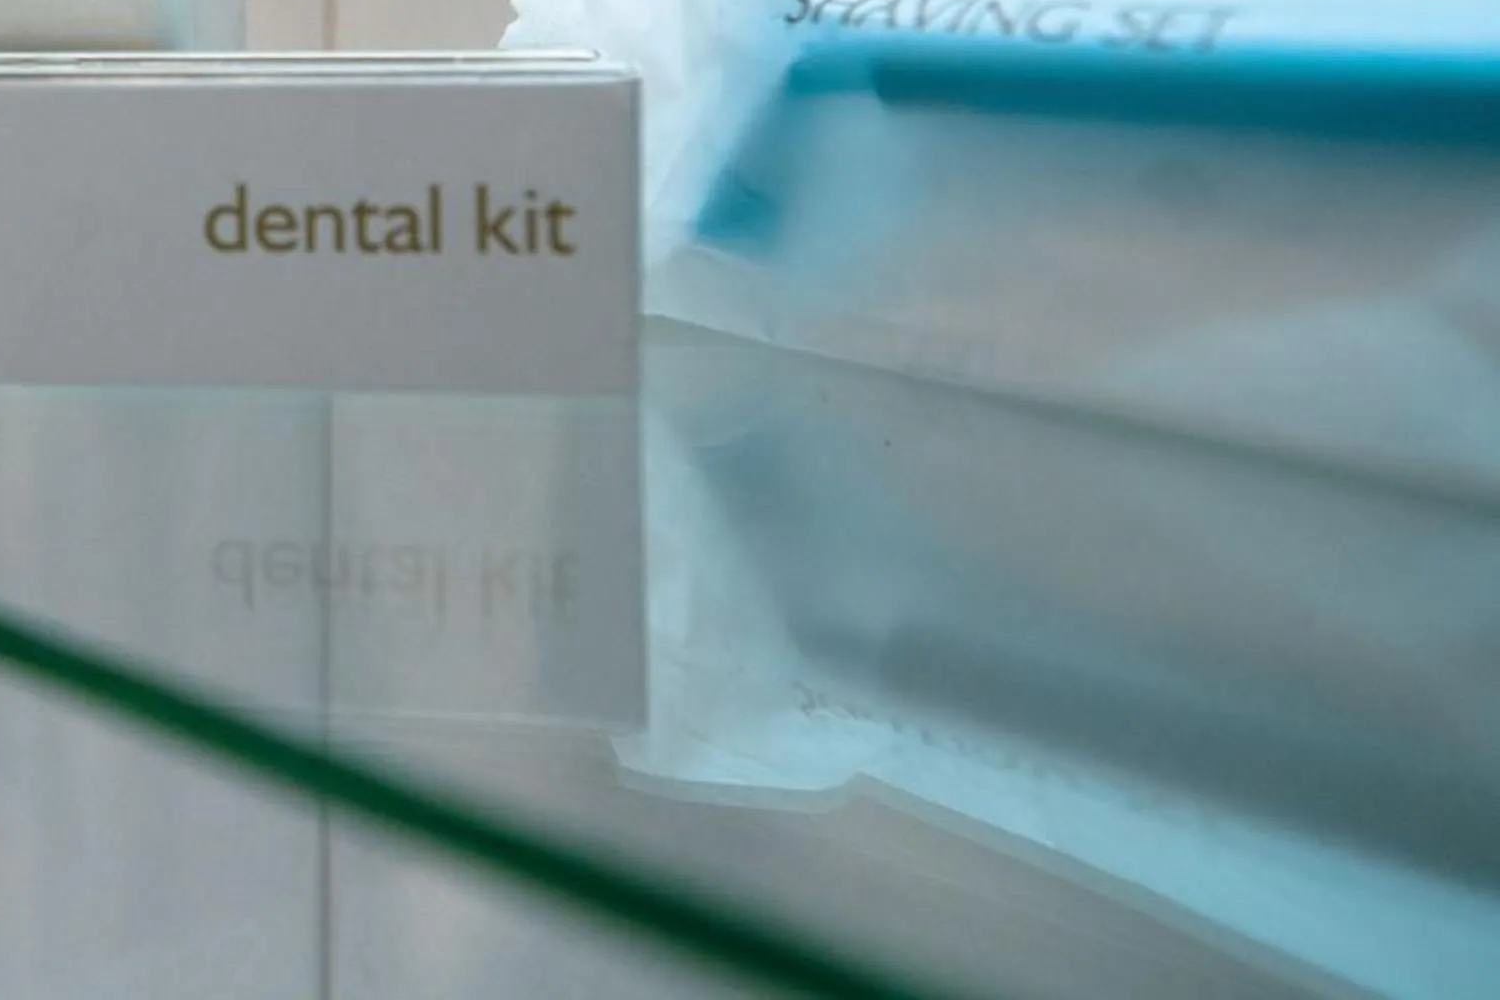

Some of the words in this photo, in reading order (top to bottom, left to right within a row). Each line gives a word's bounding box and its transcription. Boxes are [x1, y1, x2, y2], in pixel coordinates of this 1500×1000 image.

[1103, 4, 1235, 52] SET
[204, 183, 442, 254] dental
[474, 183, 577, 256] kit
